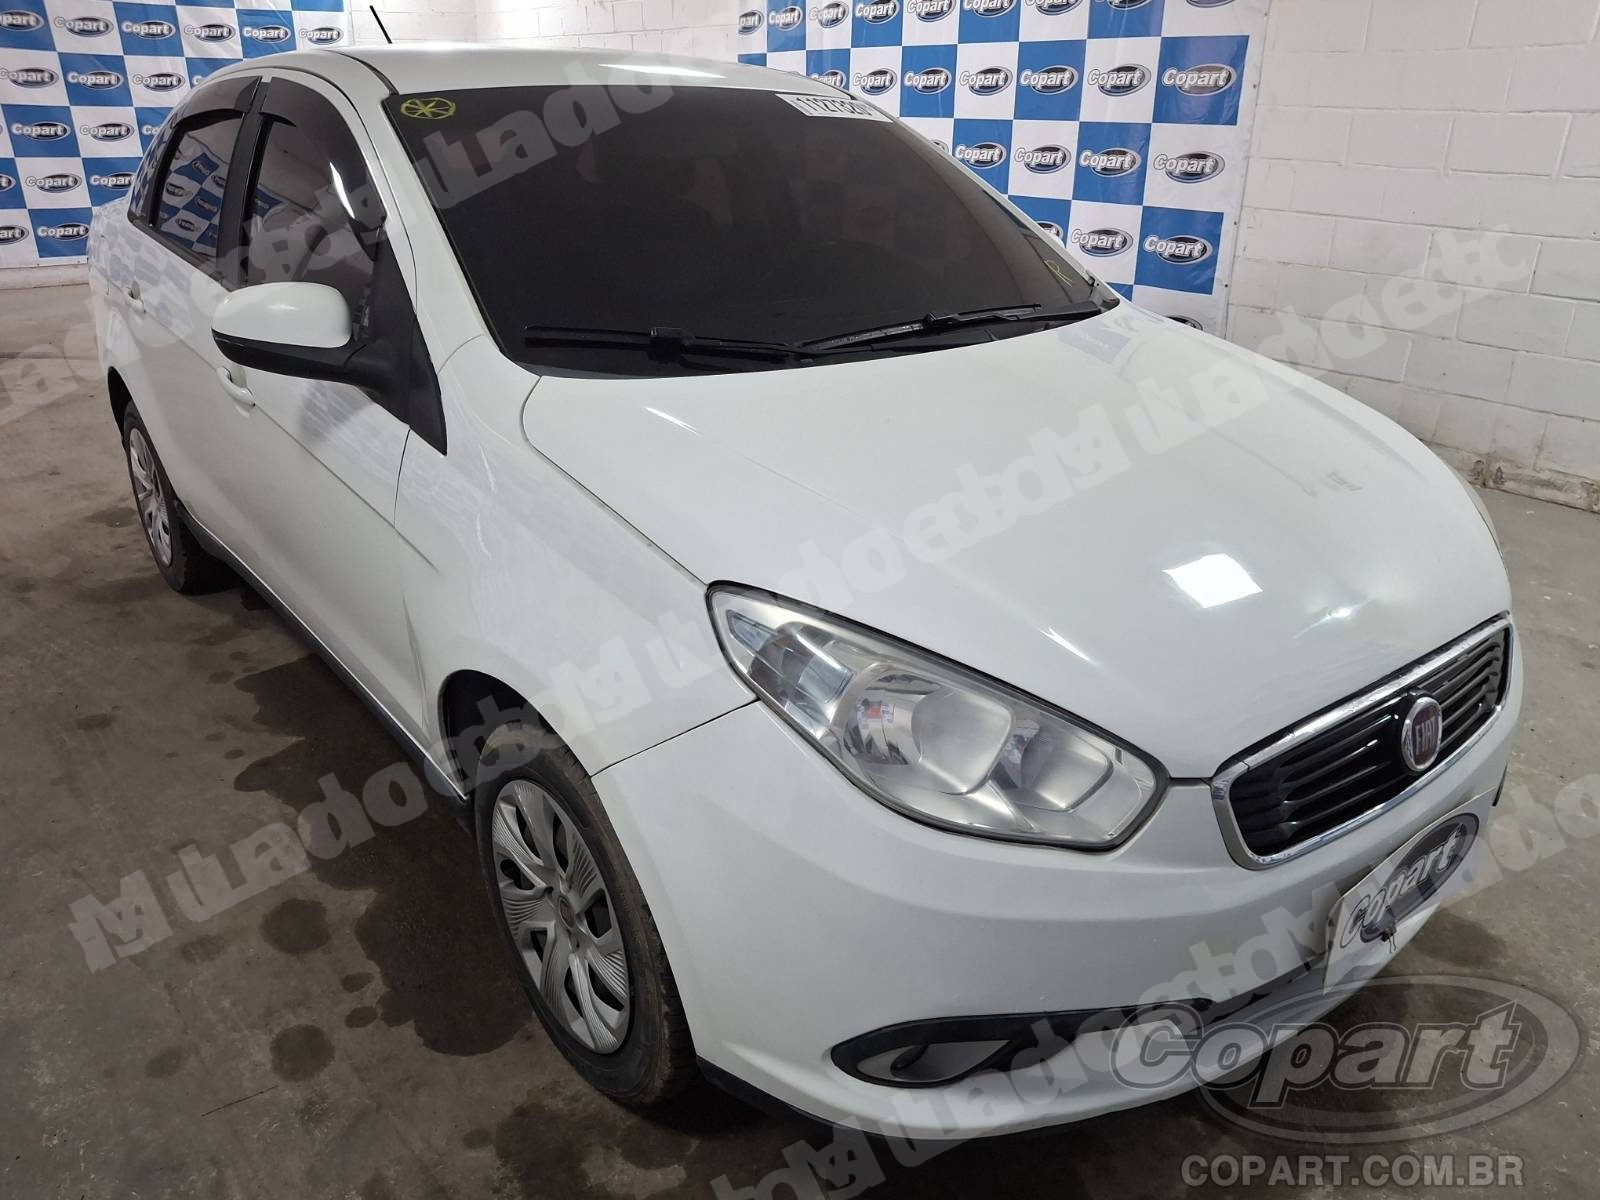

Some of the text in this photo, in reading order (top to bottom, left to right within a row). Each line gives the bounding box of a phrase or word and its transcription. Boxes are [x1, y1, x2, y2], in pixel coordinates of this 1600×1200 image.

[809, 6, 843, 23] Copart
[855, 1, 894, 19] Copart
[907, 0, 949, 15] Copart
[0, 13, 37, 28] part
[54, 17, 105, 32] Copart
[740, 16, 759, 28] part
[769, 9, 799, 27] Copart
[122, 21, 170, 34] Copart
[184, 25, 229, 38] Copart
[243, 27, 285, 41] Copart
[300, 28, 338, 41] Copart
[0, 68, 50, 84] Copart
[67, 72, 118, 86] Copart
[132, 74, 181, 88] Copart
[853, 73, 892, 89] Copart
[905, 71, 946, 88] Copart
[960, 71, 1007, 88] Copart
[1019, 69, 1071, 89] Copart
[1088, 68, 1143, 89] Copart
[1163, 67, 1227, 89] Copart
[11, 123, 64, 138] Copart
[80, 126, 127, 140] Copart
[955, 144, 1000, 163] Copart
[1014, 147, 1063, 166] Copart
[1079, 151, 1132, 170] Copart
[1153, 154, 1214, 175] Copart
[25, 176, 75, 190] Copart
[37, 226, 86, 239] Copart
[1071, 229, 1123, 249] Copart
[1144, 236, 1203, 258] Copart
[1340, 823, 1464, 948] Copart
